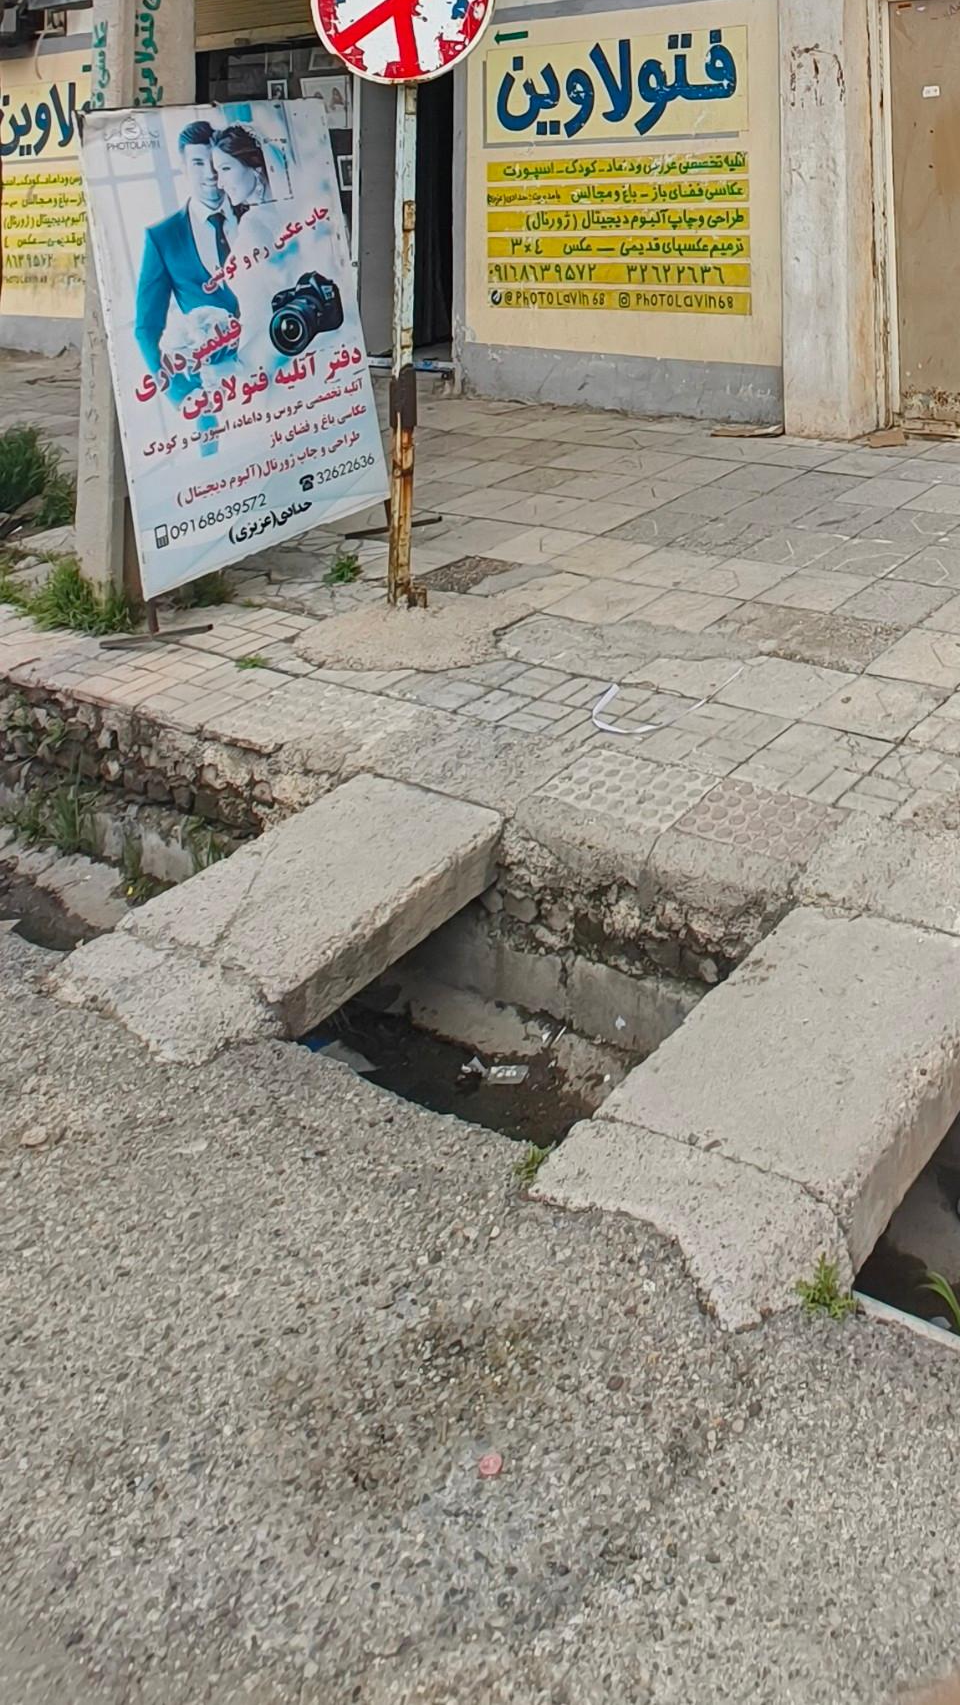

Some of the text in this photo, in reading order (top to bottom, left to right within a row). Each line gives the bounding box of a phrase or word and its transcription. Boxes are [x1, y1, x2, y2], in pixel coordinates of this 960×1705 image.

[497, 29, 737, 138] فتولاوین
[706, 182, 745, 200] عکاسی
[306, 205, 330, 230] چاپ
[581, 211, 630, 231] دیجیتال
[707, 209, 745, 229] طراحی
[274, 222, 303, 249] عکس
[563, 237, 593, 256] عکس
[275, 351, 317, 390] آتلیه
[325, 344, 362, 384] دفتر
[337, 404, 367, 425] عکاسی
[328, 431, 361, 454] طراحی
[316, 453, 375, 485] 32622636
[170, 493, 267, 540] 09168639572
